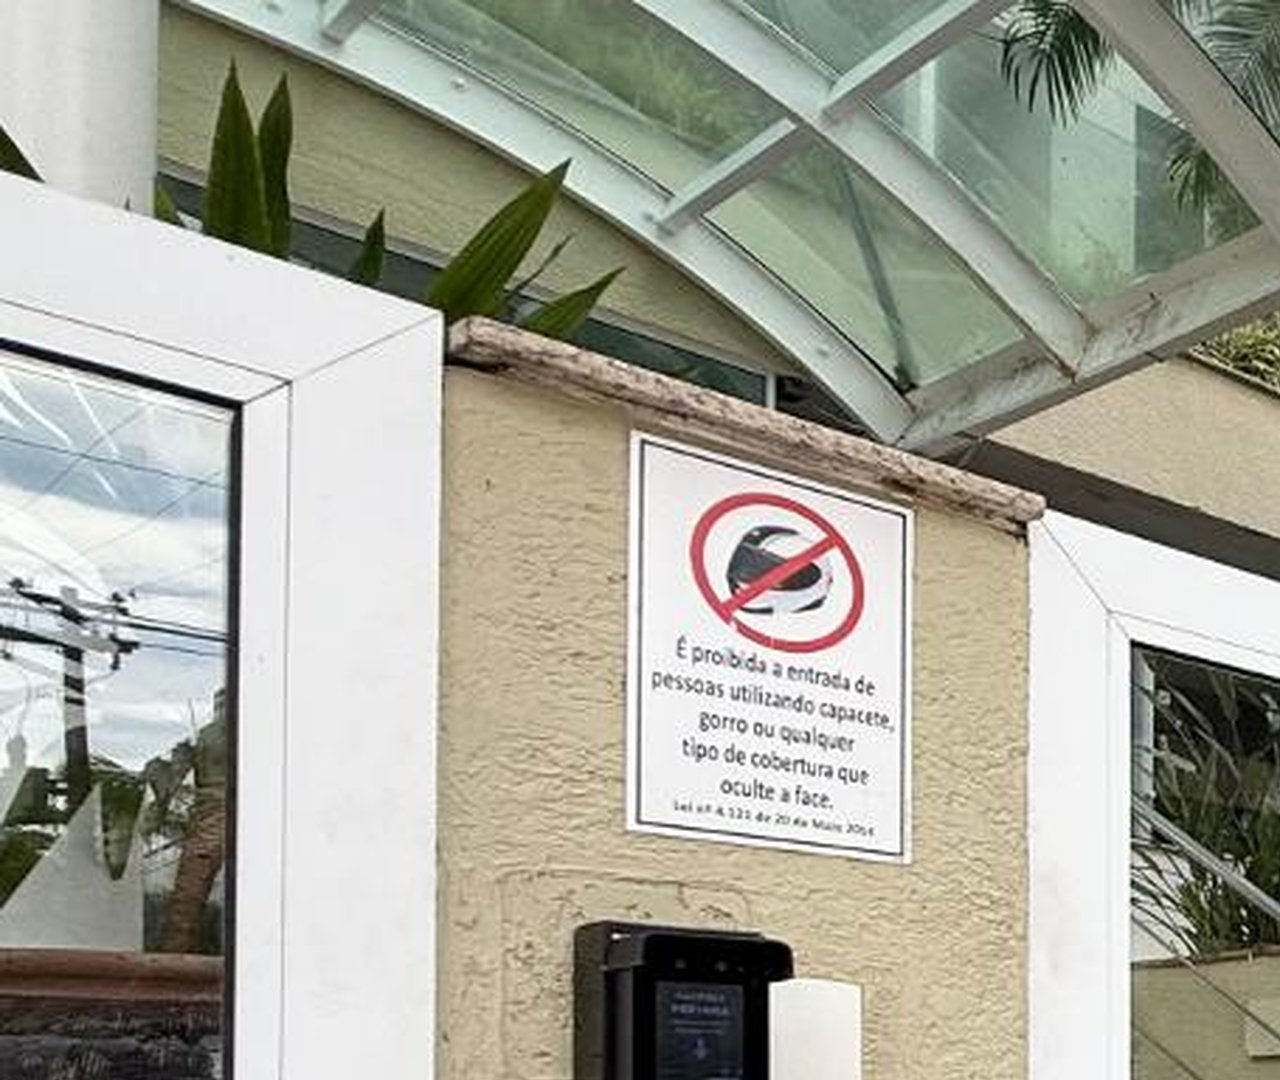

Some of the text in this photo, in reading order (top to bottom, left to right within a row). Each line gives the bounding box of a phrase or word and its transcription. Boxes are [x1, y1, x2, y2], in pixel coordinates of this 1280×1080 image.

[676, 635, 876, 696] É proibida a entrada de
[652, 671, 895, 732] pessoas utilizando capacete,
[698, 711, 855, 752] gorro ou qualquer
[682, 737, 870, 785] tipo de cobertura que
[720, 778, 834, 809] oculte a face.
